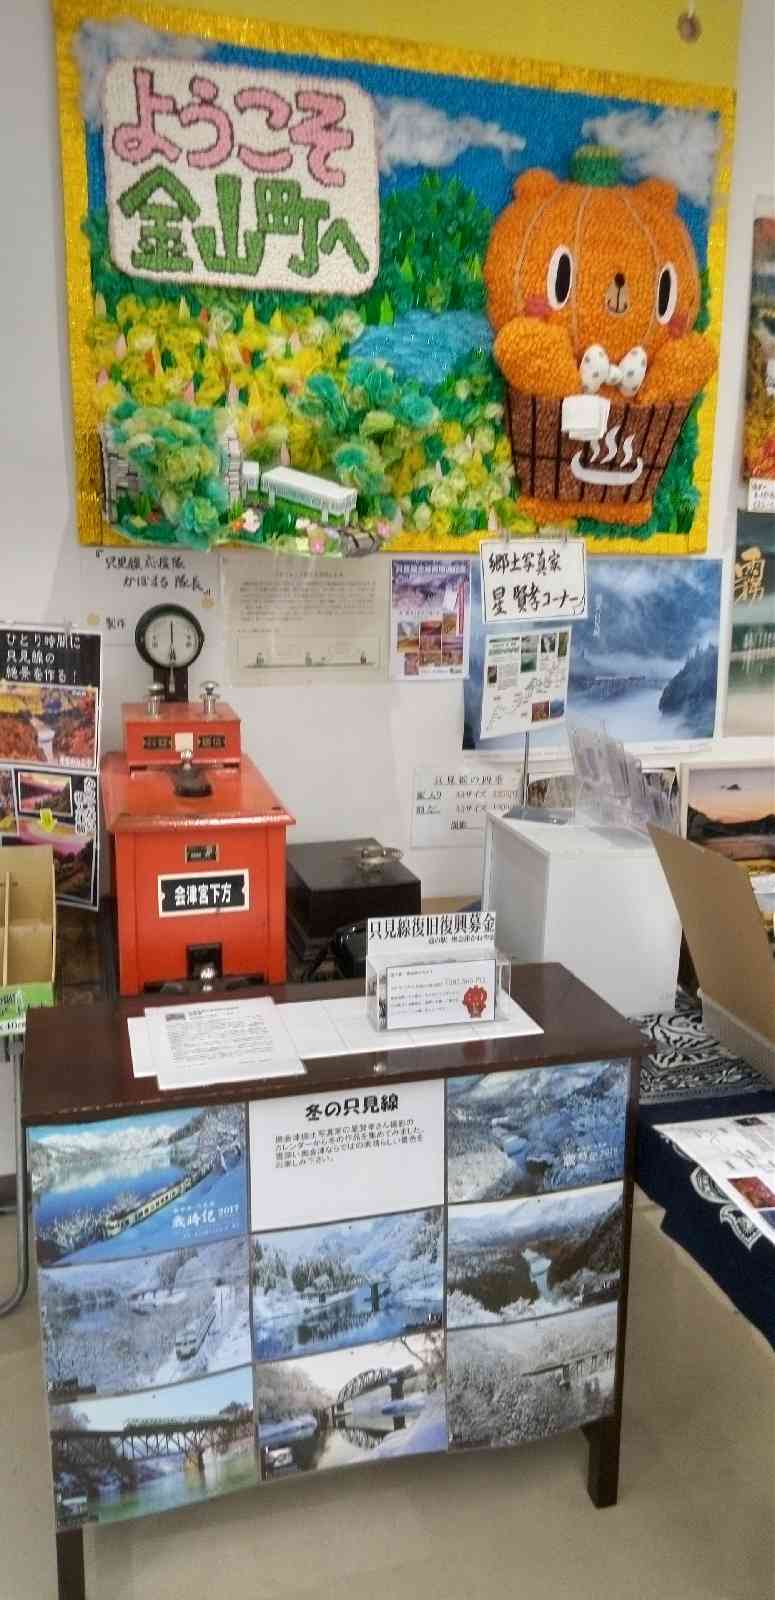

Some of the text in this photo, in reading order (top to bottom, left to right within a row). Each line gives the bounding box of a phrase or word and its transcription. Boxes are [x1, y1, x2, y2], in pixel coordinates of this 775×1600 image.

[112, 67, 354, 188] ようこそ
[117, 164, 370, 277] 金山町へ
[489, 547, 562, 577] 郷土写真家
[6, 632, 81, 650] ひとり時間に
[6, 650, 55, 665] 只見線の
[174, 881, 232, 906] 会津宮下方
[368, 911, 496, 941] 只見線復旧復興募金
[305, 1093, 400, 1121] 冬の只見線
